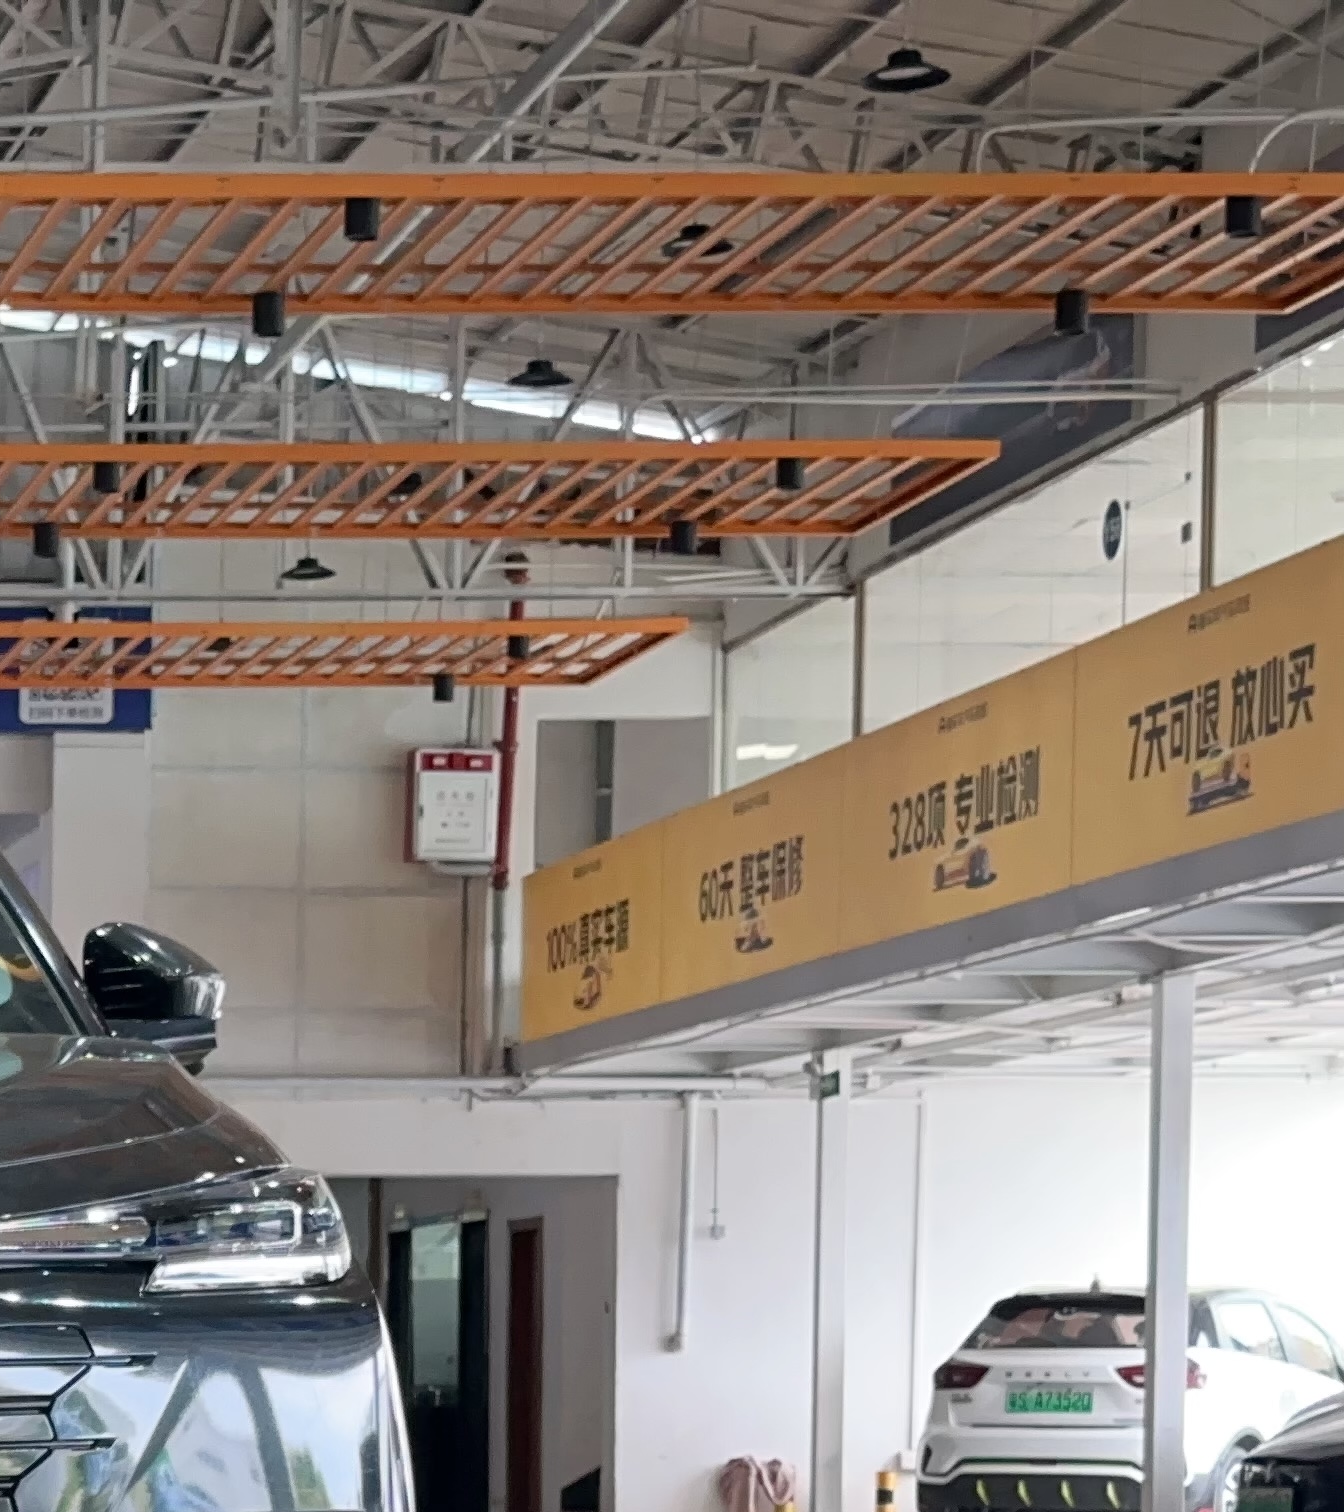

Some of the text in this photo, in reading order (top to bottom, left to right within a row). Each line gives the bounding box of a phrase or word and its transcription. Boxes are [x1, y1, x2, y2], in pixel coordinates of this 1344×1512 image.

[1128, 643, 1316, 781] 7天可退 放心买
[888, 744, 1041, 860] 328项 专业检测
